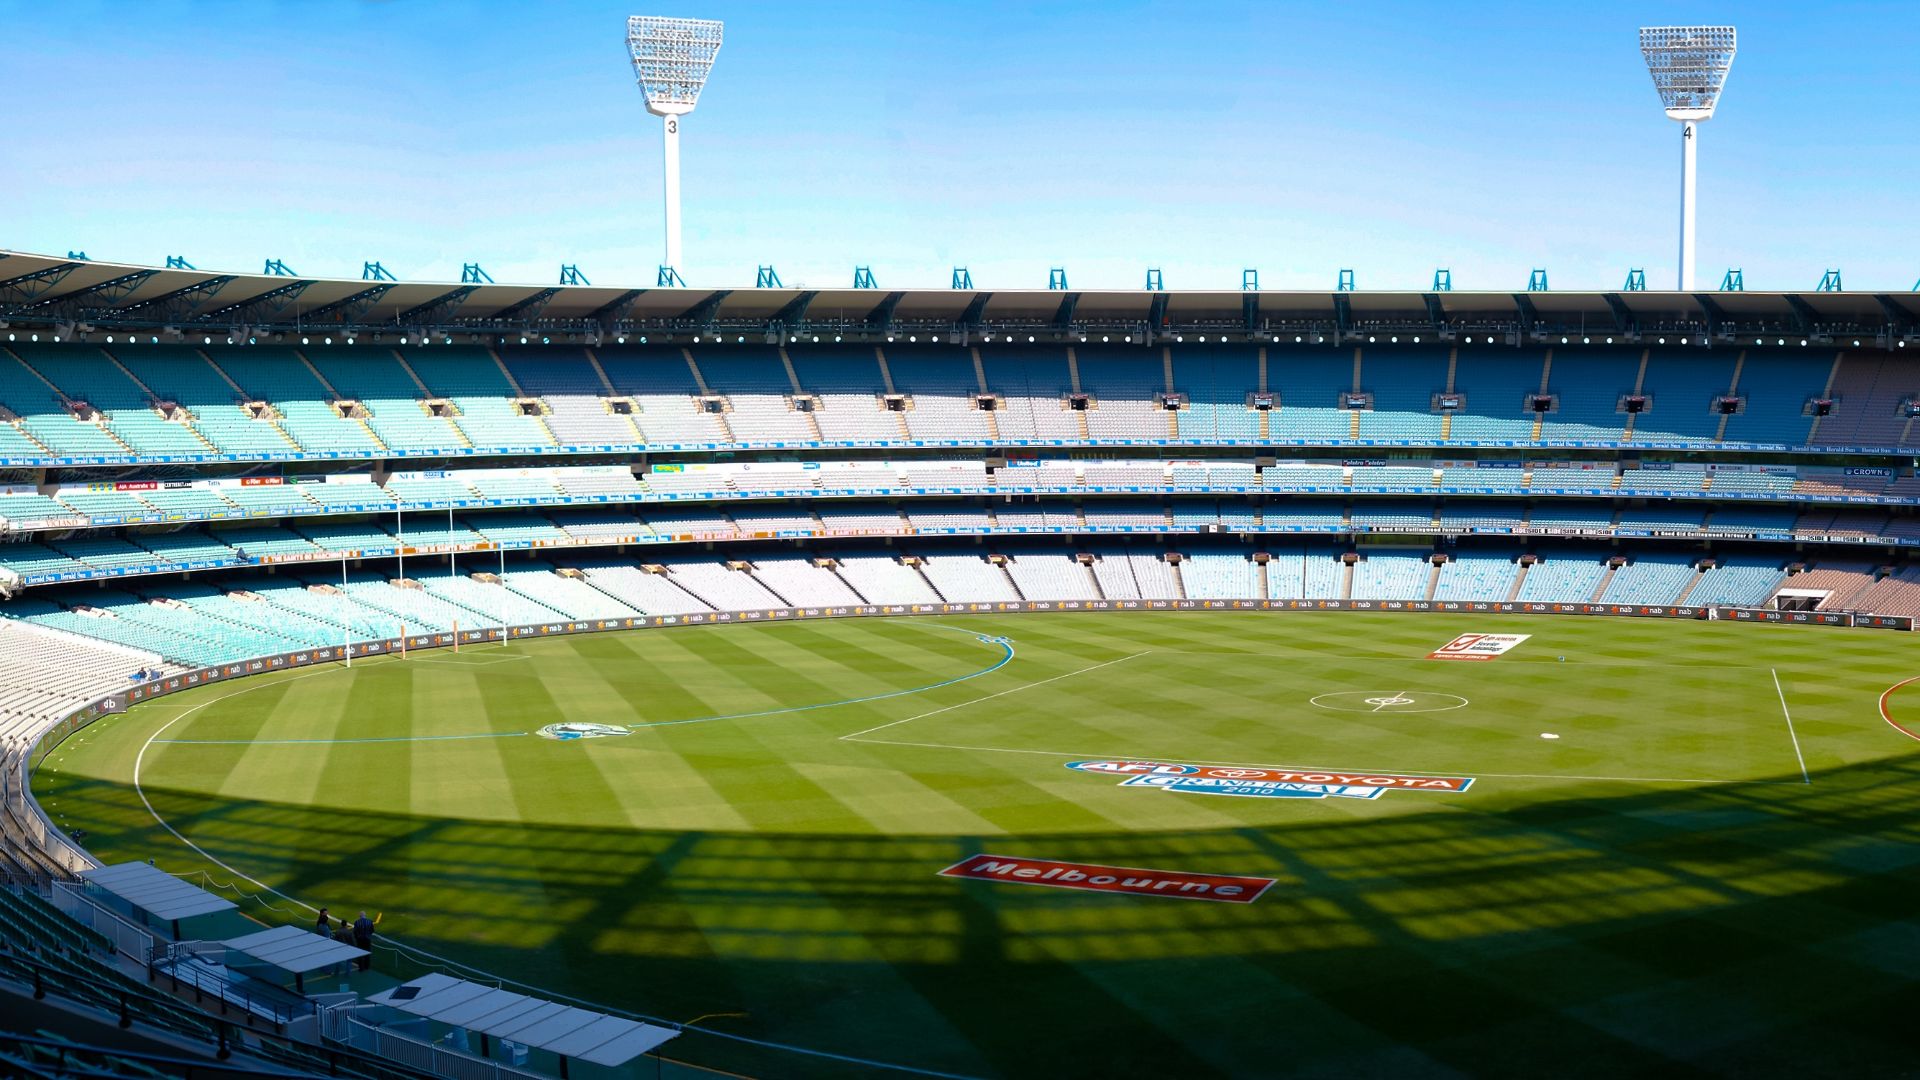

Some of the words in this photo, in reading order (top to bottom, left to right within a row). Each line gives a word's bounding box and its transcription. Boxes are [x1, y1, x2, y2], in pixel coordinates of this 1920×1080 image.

[668, 120, 676, 133] 3
[1684, 126, 1692, 140] 4
[1074, 762, 1186, 775] AFL
[1278, 773, 1452, 788] TOYOTA
[1144, 775, 1258, 788] GRAND
[1263, 780, 1369, 796] FINAL
[1222, 786, 1275, 795] 2010
[972, 861, 1243, 896] Melbourne
